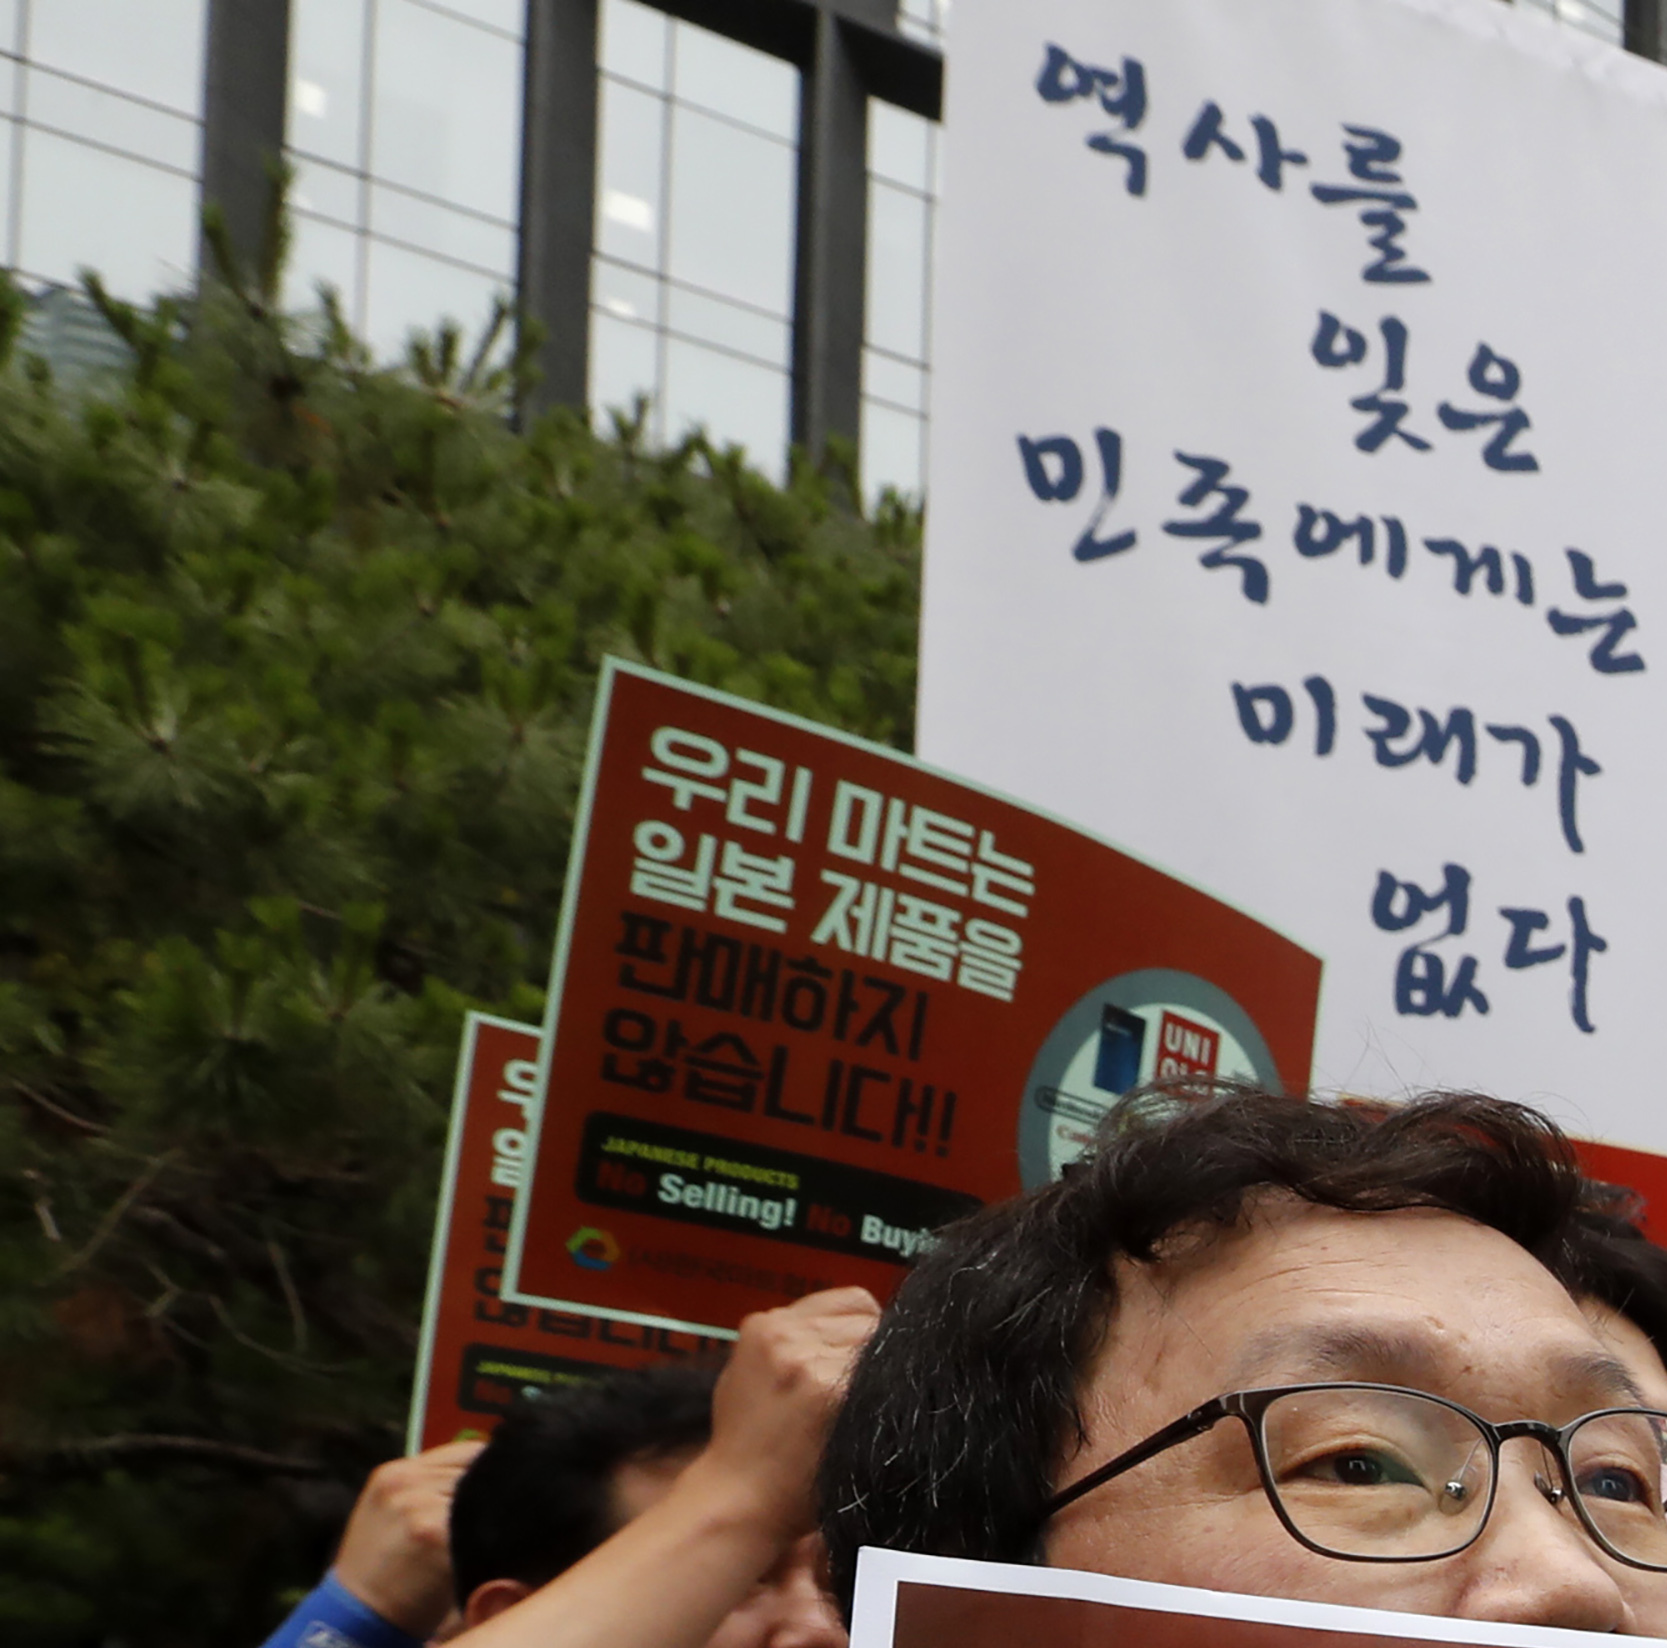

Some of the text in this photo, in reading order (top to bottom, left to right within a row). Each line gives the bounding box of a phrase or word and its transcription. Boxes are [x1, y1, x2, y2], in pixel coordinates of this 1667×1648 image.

[1036, 42, 1432, 285] 역사를
[1311, 309, 1539, 473] 잊은
[1017, 427, 1646, 674] 민족에게는
[643, 724, 1036, 917] 우리 마트는
[1232, 675, 1602, 853] 미래가
[614, 910, 931, 1063] 판매하지
[630, 819, 1025, 1000] 일본 제품을
[1371, 863, 1606, 1033] 없다
[602, 1008, 958, 1159] 않습니다!!
[1164, 1021, 1212, 1066] UNI
[597, 1162, 647, 1197] No
[658, 1173, 798, 1230] Selling!
[806, 1206, 852, 1238] No
[602, 1136, 799, 1190] JAPANESE PRODUCTS
